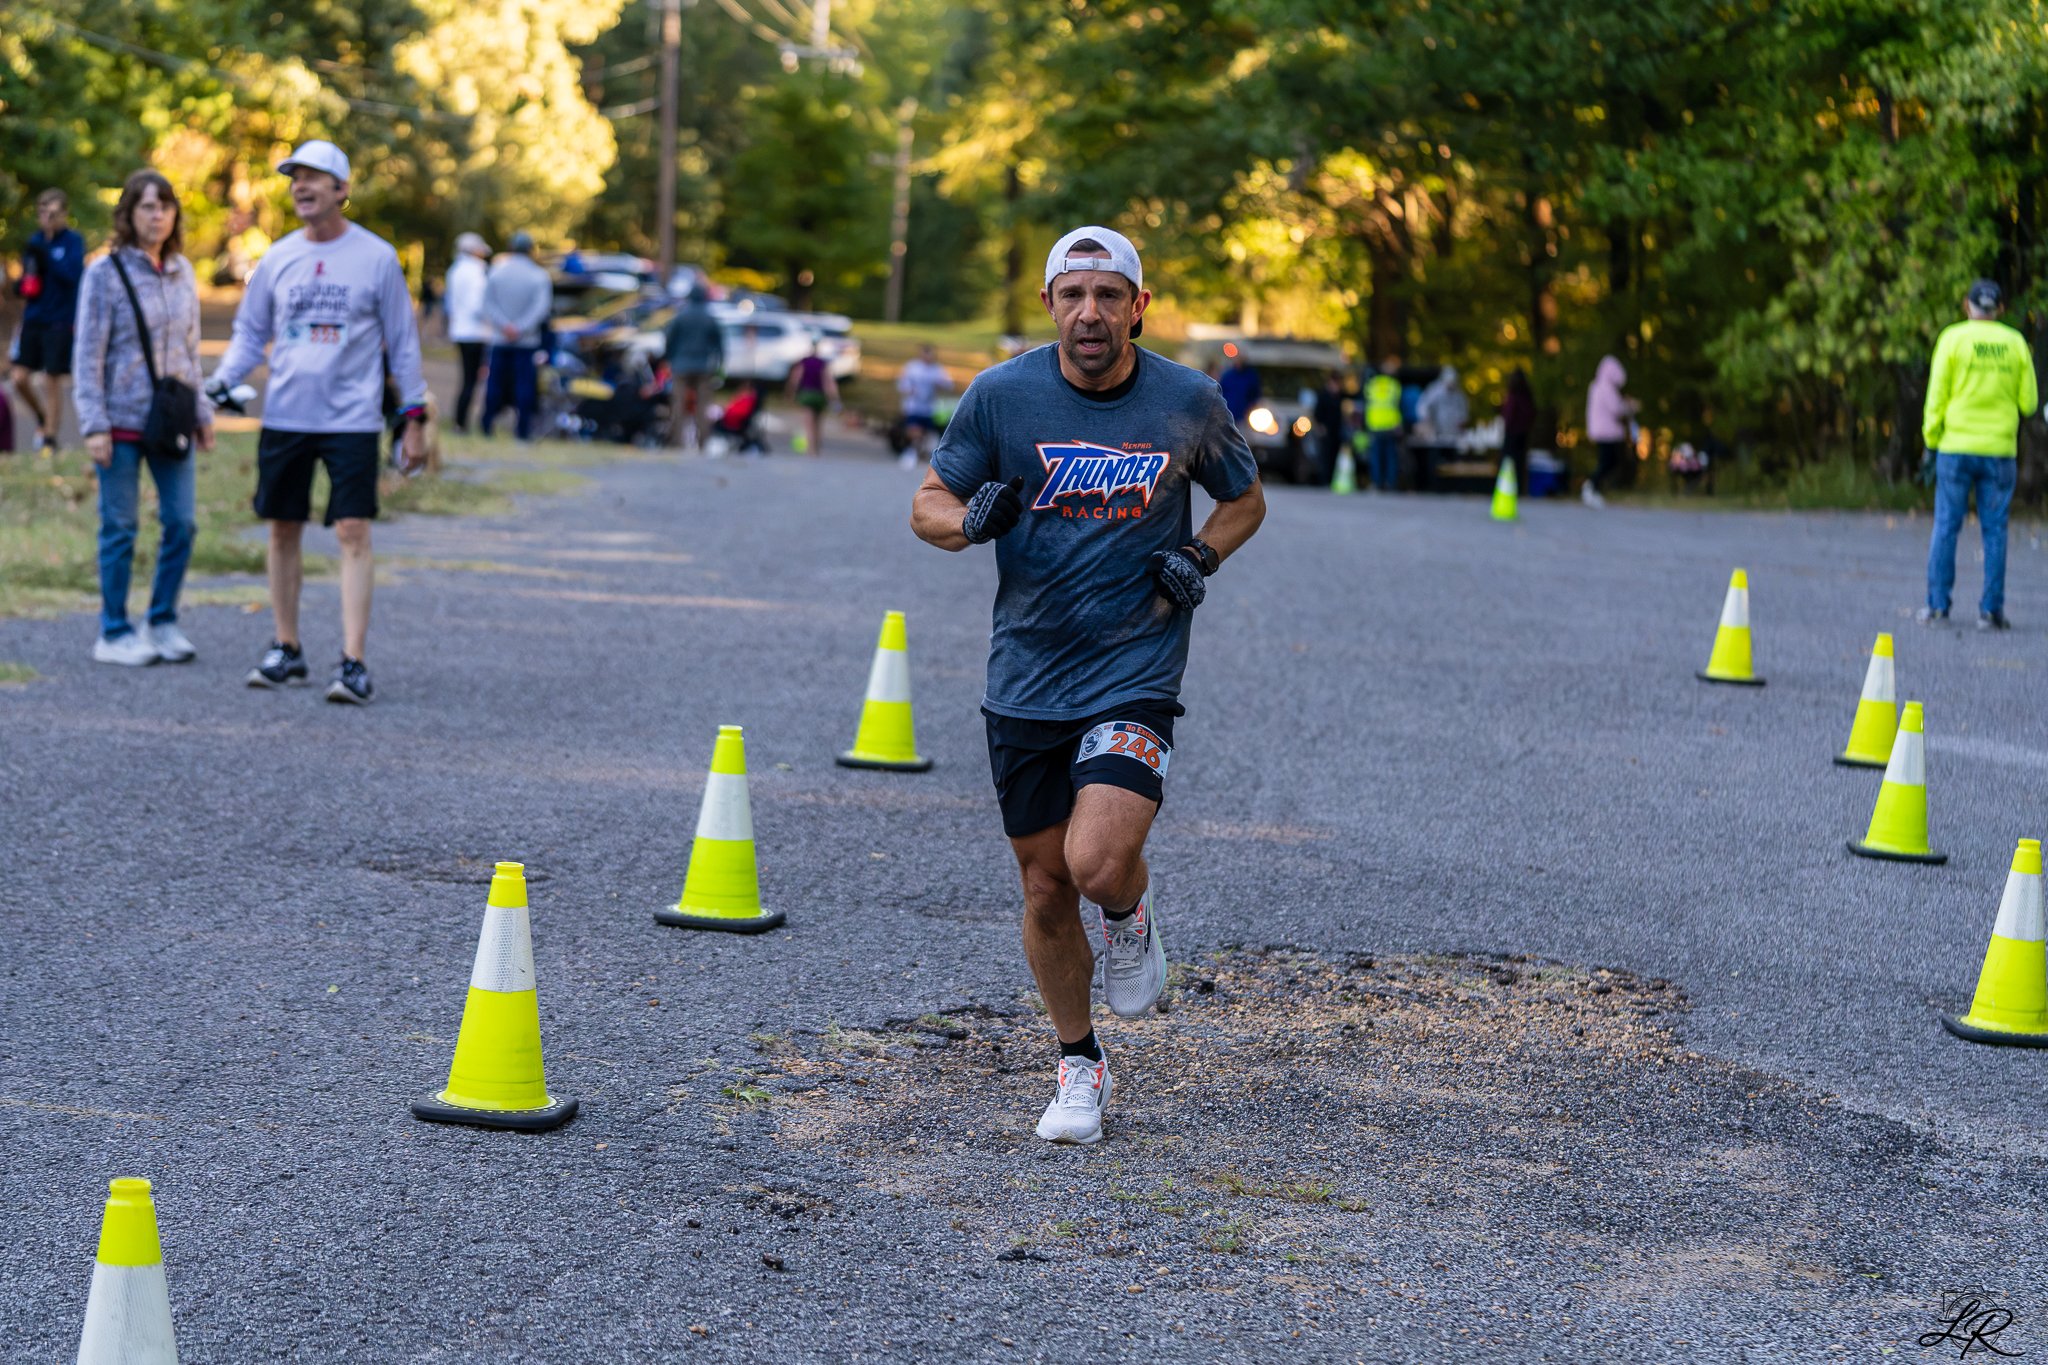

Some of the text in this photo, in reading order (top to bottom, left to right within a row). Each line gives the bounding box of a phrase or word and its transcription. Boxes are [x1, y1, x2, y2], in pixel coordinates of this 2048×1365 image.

[1031, 439, 1171, 510] THUNDER
[1062, 505, 1143, 520] RACING
[1106, 732, 1161, 769] 246
